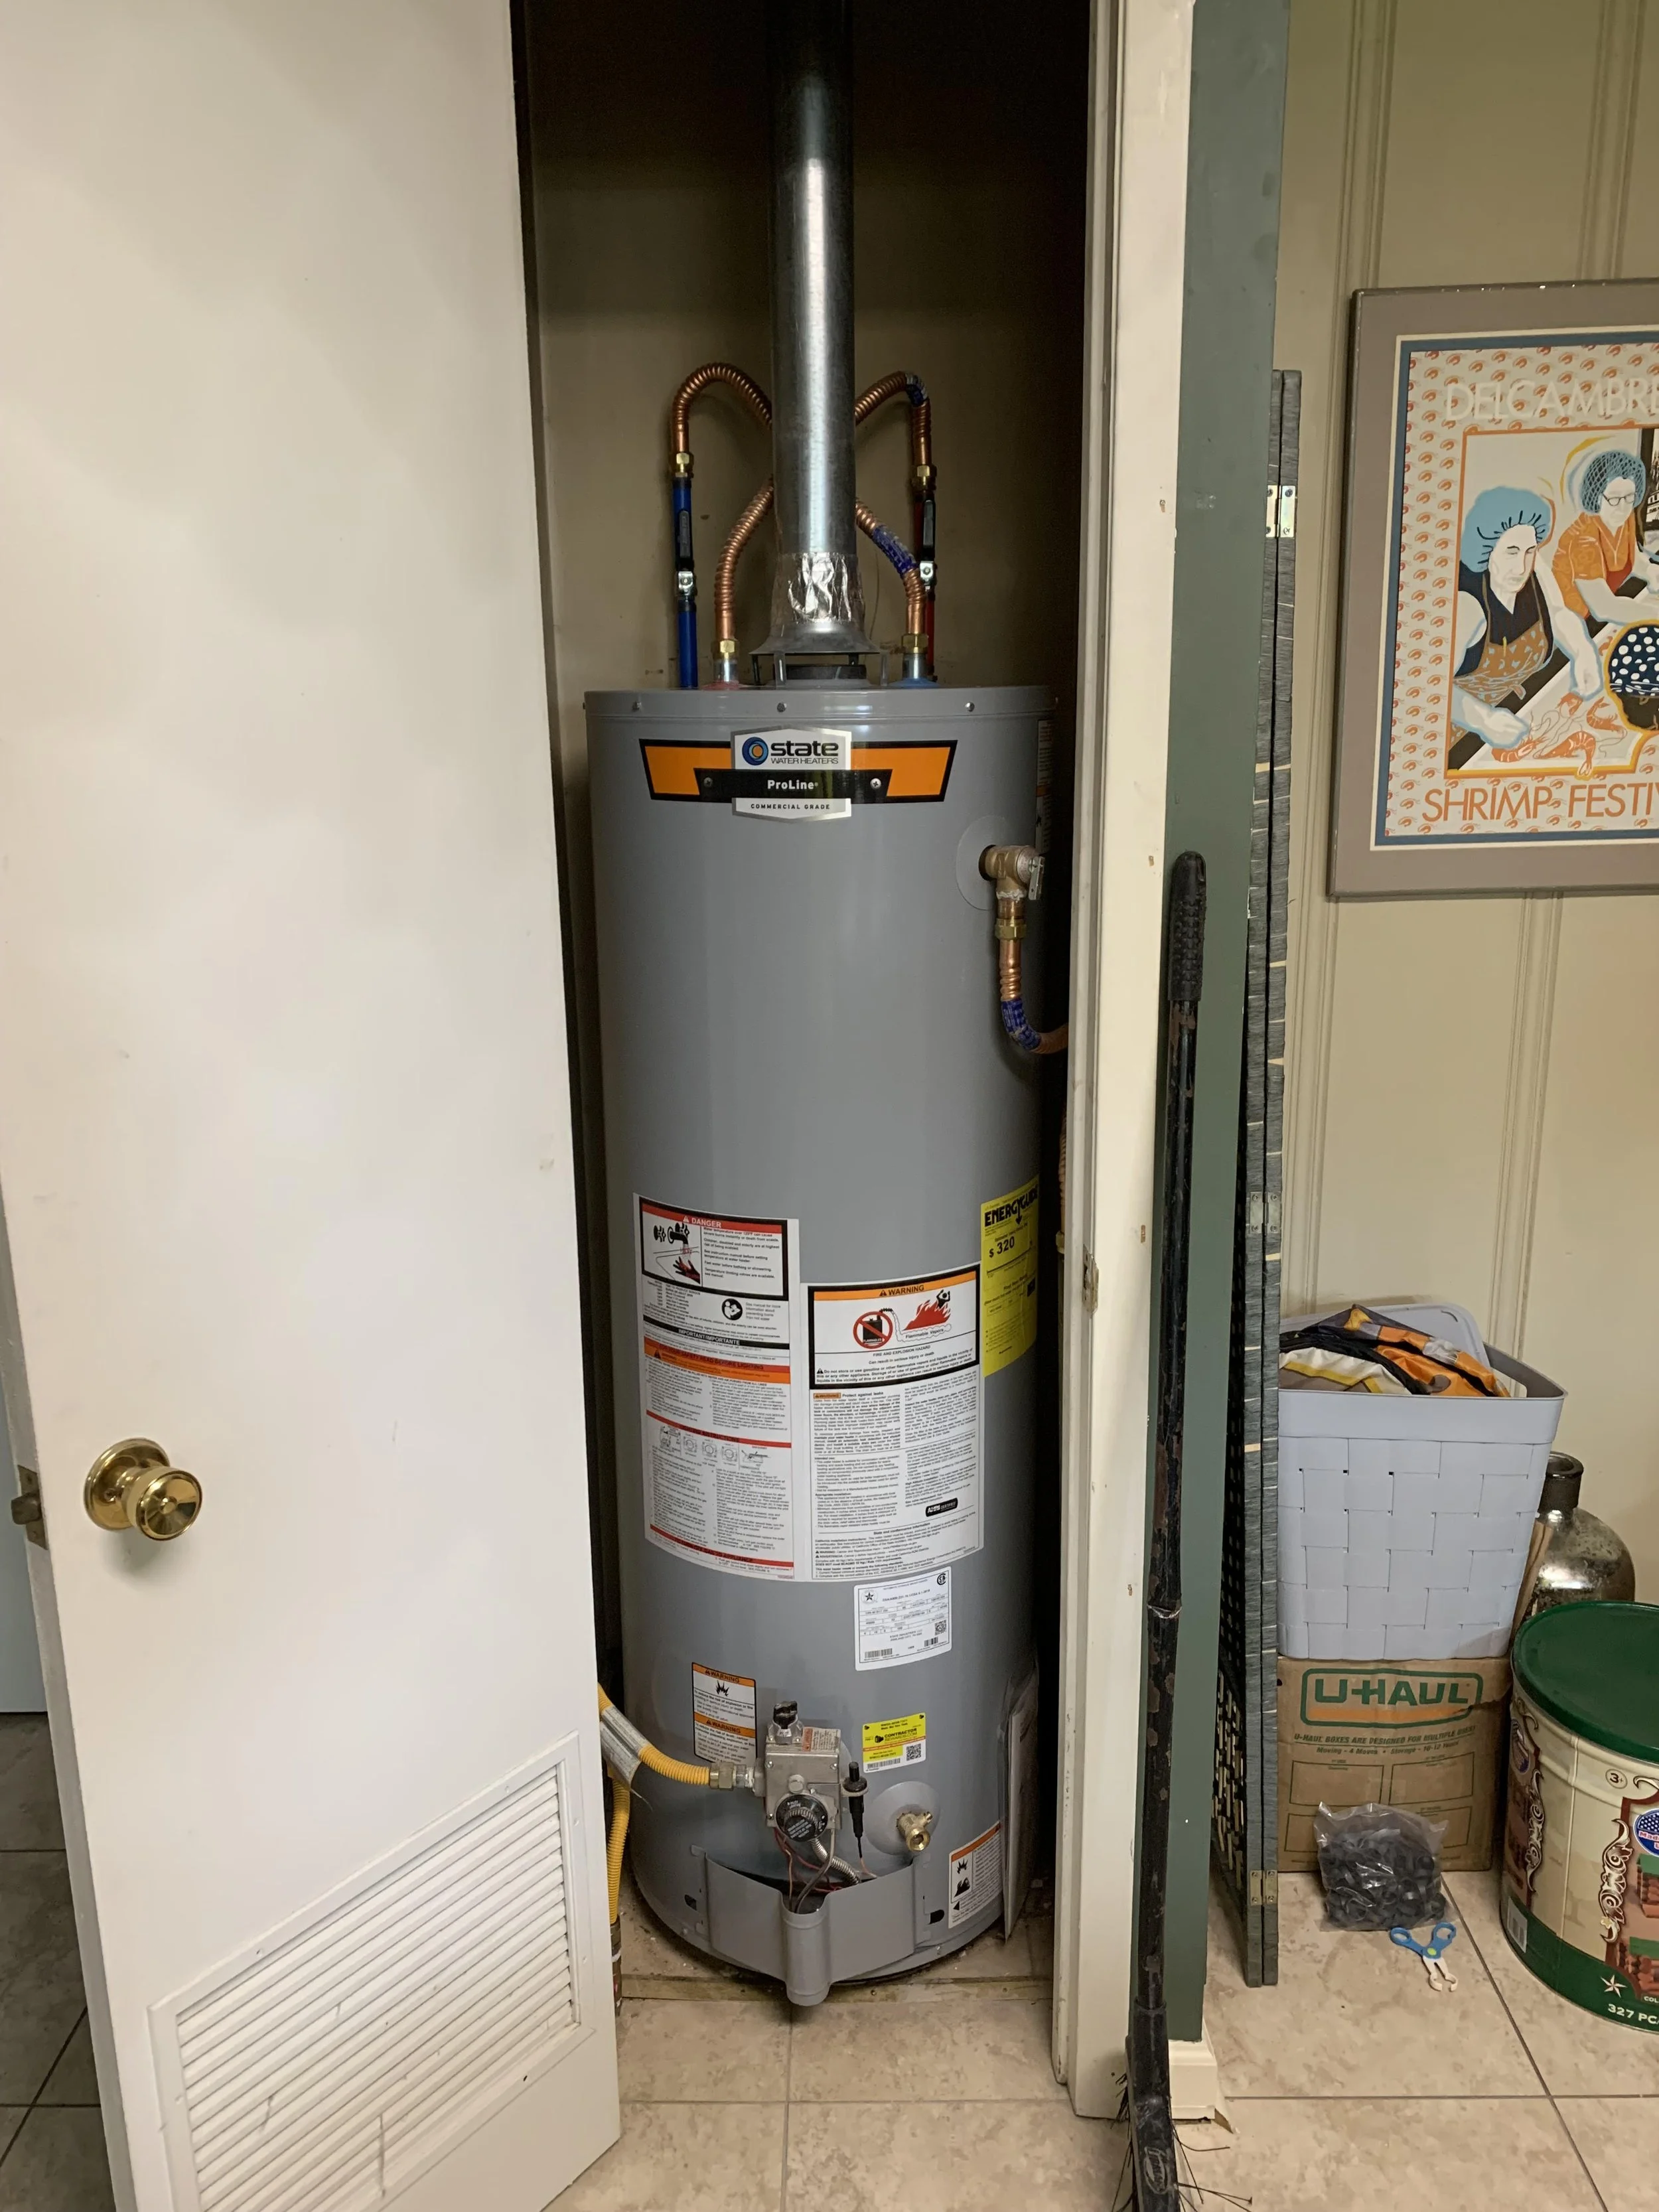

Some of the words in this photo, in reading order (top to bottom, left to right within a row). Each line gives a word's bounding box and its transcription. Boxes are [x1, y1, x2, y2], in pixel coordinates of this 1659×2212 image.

[770, 741, 839, 756] state
[1422, 786, 1553, 822] SHRIMP
[1568, 782, 1659, 818] FESTI
[691, 1218, 721, 1228] DANGER
[997, 1236, 1015, 1254] 320
[889, 1285, 924, 1295] WARNING
[710, 1671, 740, 1683] WARNING
[1315, 1678, 1469, 1706] U-HAUL
[711, 1722, 741, 1733] WARNING
[885, 1728, 917, 1738] CONTRACTOR
[1294, 1733, 1322, 1742] U-HAUL
[1423, 1730, 1455, 1741] MULTIPLE
[1608, 2003, 1634, 2018] 327
